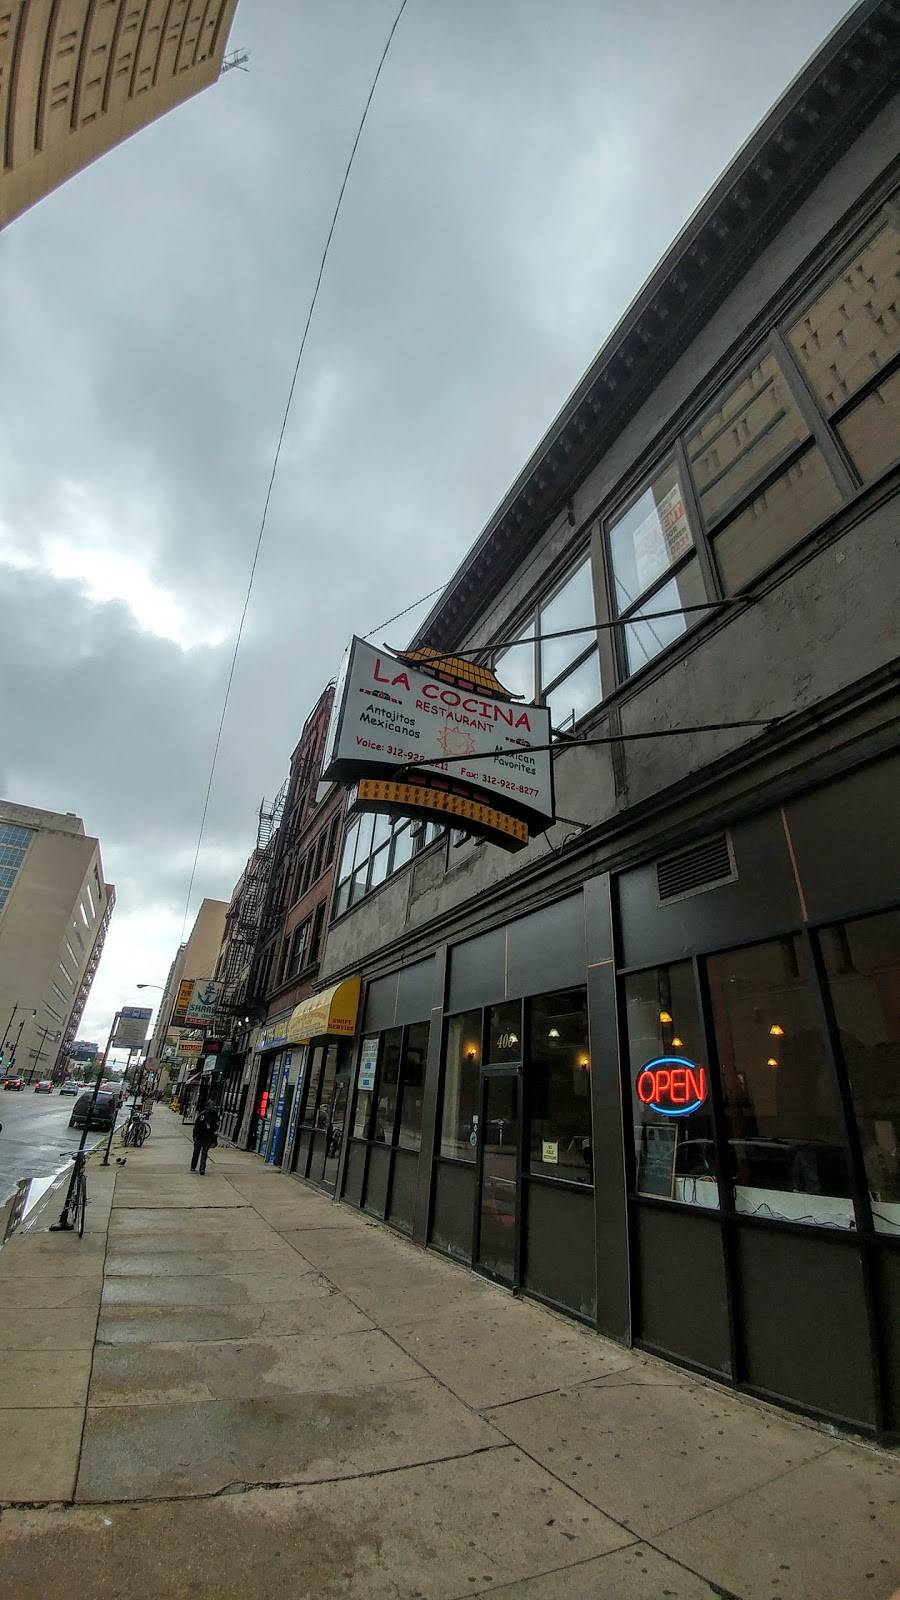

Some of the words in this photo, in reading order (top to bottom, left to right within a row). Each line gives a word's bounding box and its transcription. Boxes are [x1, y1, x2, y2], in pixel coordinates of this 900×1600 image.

[373, 658, 410, 691] LA
[422, 684, 531, 732] COCINA
[360, 712, 420, 739] Mexicanos
[366, 704, 416, 726] Antojitos
[415, 699, 494, 733] RESTAURANT
[356, 735, 384, 751] Voice:
[494, 756, 536, 775] Favorites
[495, 745, 535, 765] Mxican
[461, 767, 479, 780] Fax:
[637, 1067, 705, 1104] OPEN
